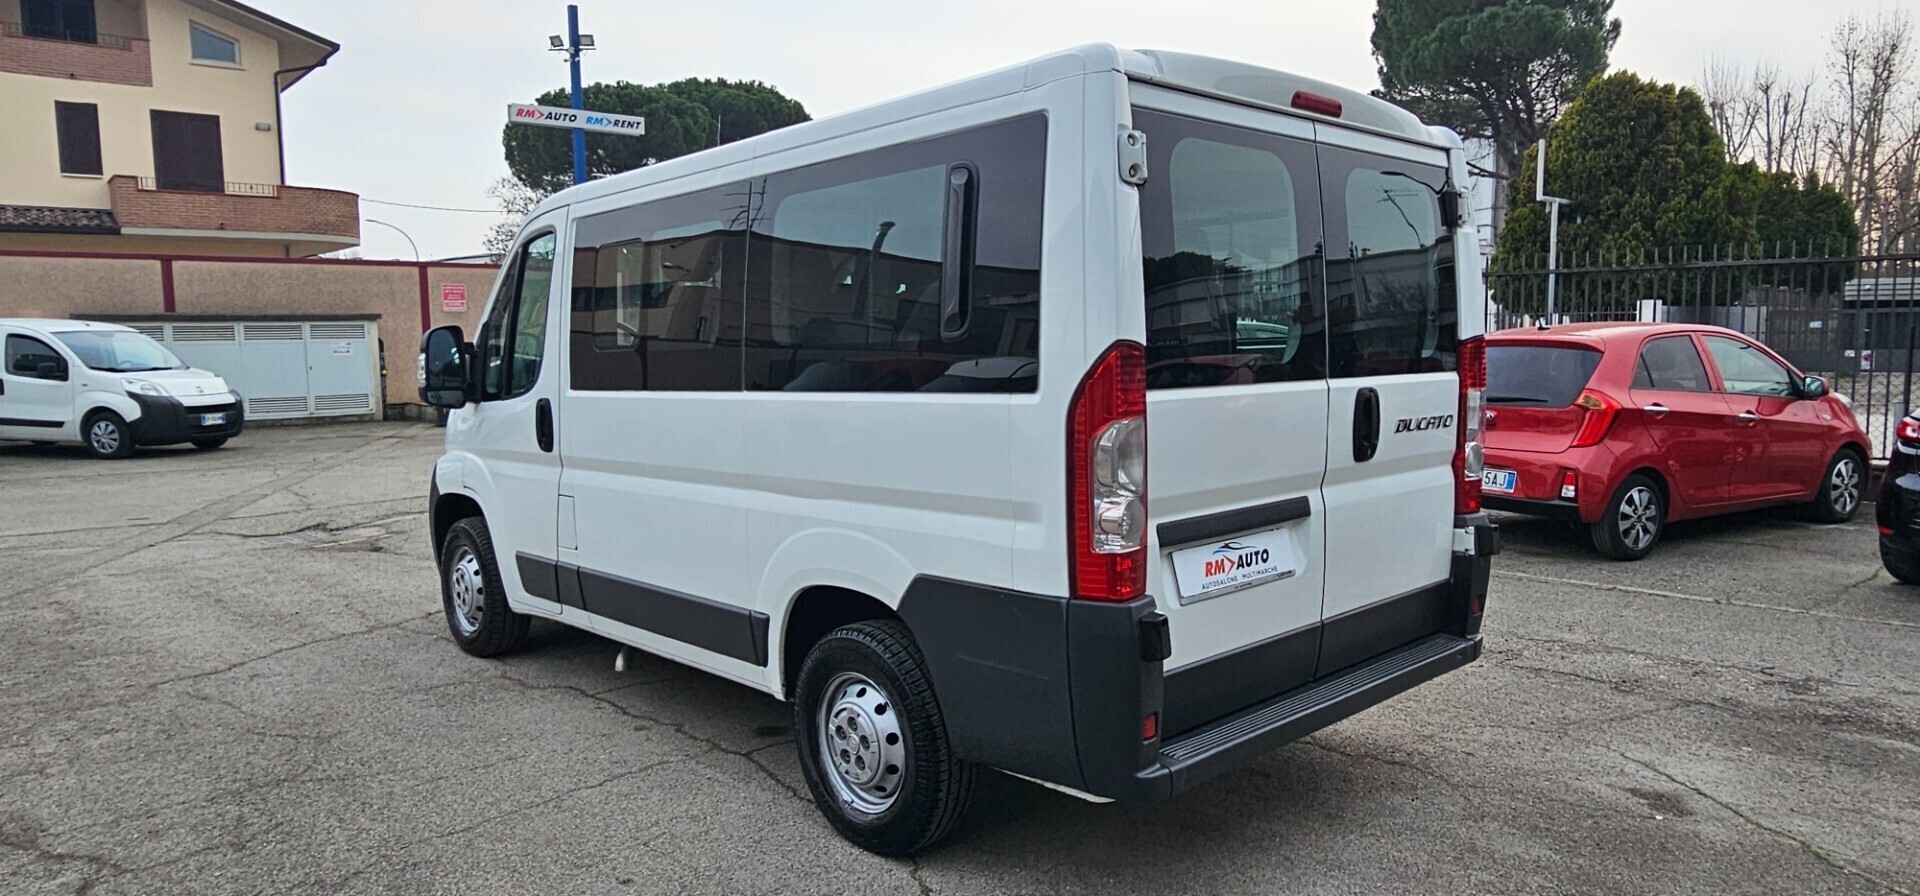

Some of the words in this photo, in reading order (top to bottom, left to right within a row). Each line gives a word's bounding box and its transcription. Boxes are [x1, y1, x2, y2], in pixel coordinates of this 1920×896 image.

[544, 112, 577, 122] AUTO
[612, 119, 642, 130] RENT
[1394, 414, 1454, 434] DUCATO
[1484, 472, 1506, 487] 5AJ
[1236, 548, 1269, 570] AUTO
[1202, 576, 1237, 590] AUTOSALONE
[1242, 566, 1278, 579] MULTIMARCHE
